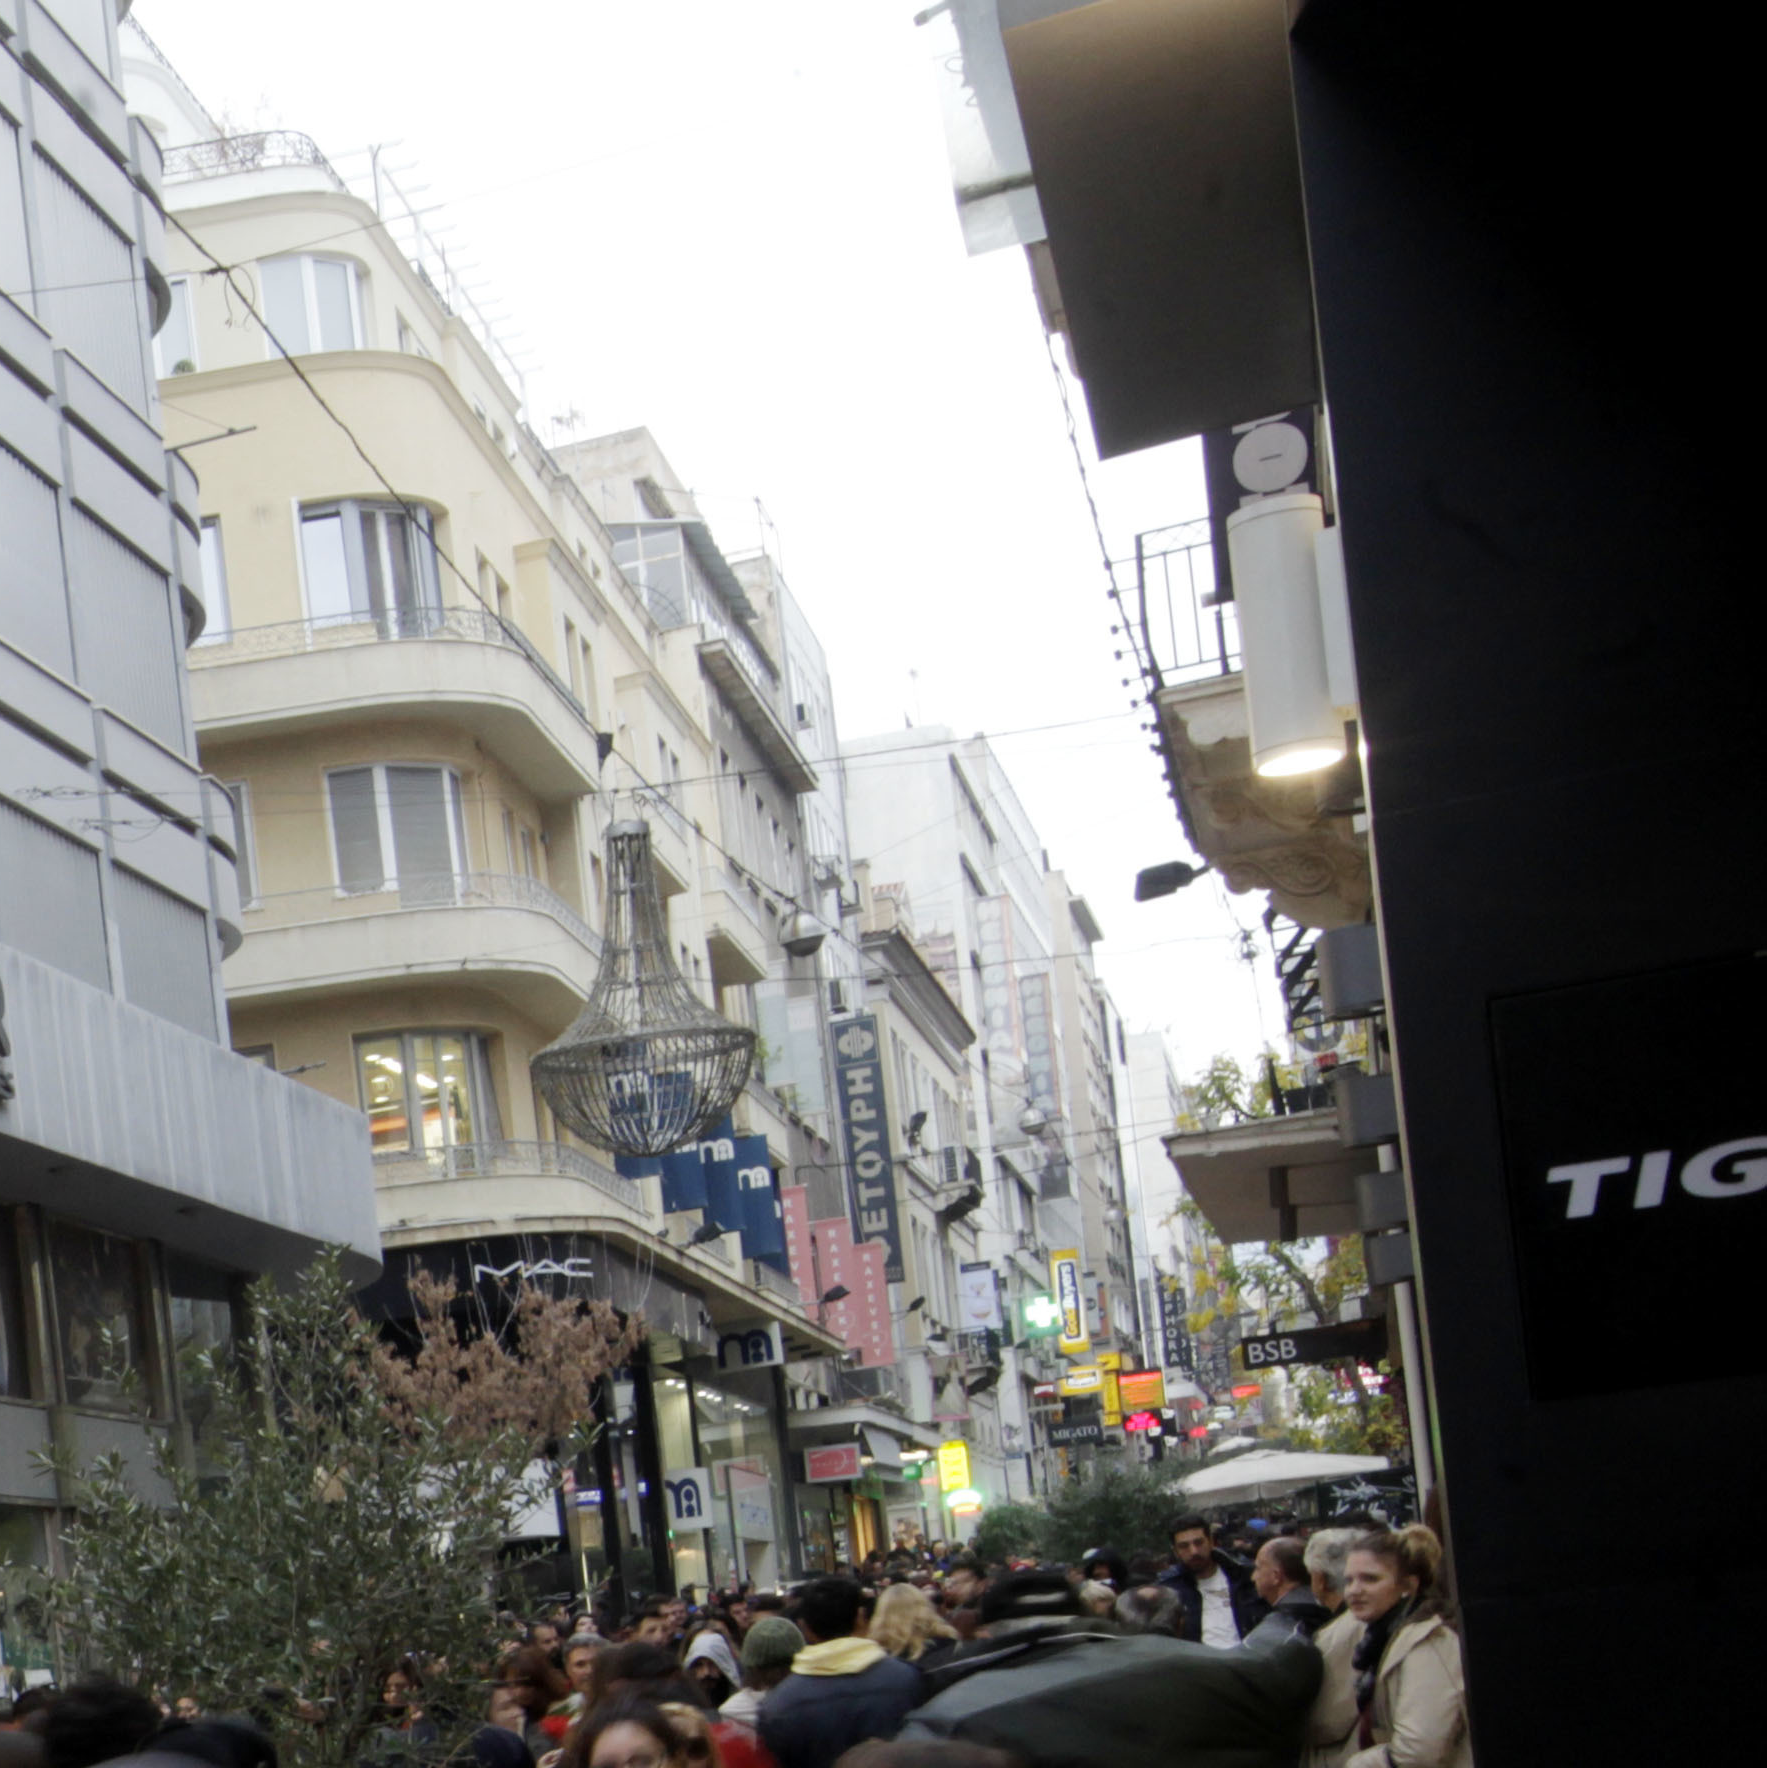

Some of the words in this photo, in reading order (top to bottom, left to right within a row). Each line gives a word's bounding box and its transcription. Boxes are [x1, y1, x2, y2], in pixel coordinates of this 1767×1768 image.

[474, 1258, 594, 1283] MAC
[1248, 1338, 1297, 1364] BSB
[1051, 1425, 1098, 1440] MIGATO
